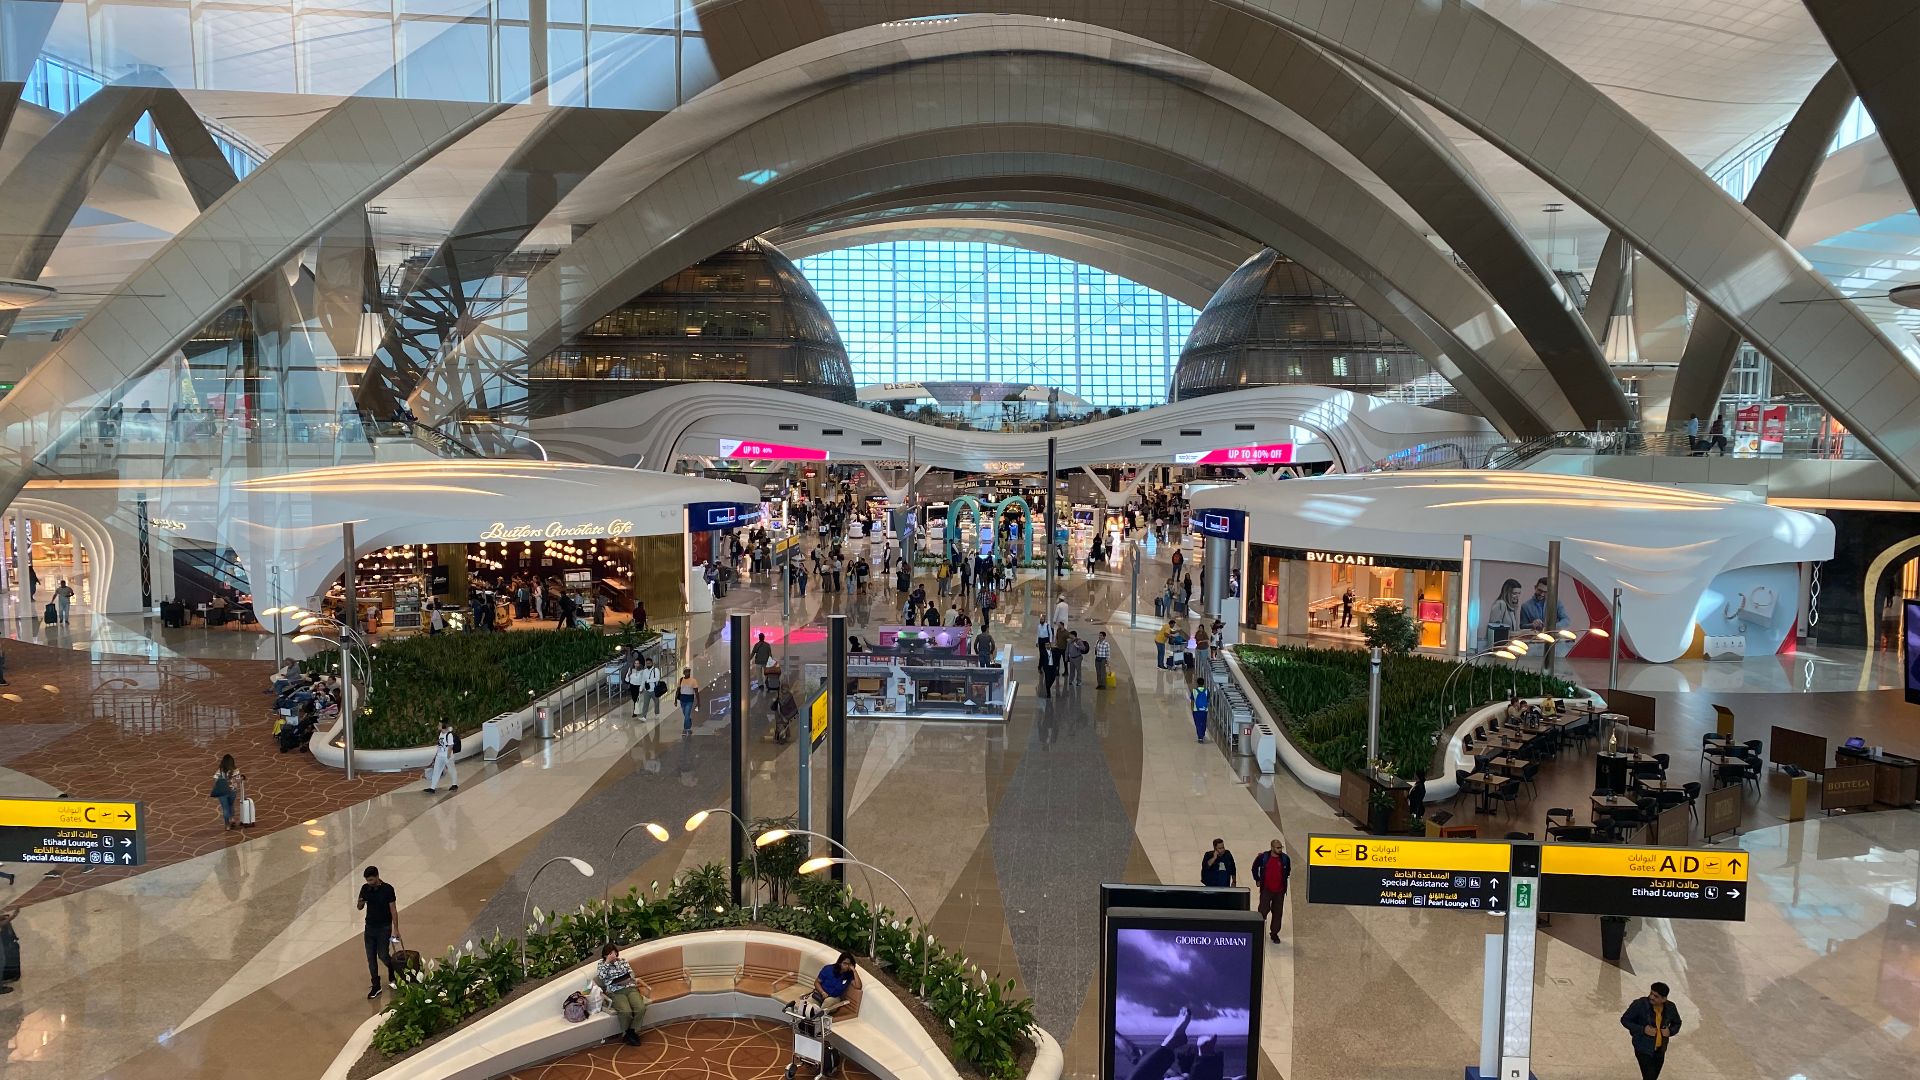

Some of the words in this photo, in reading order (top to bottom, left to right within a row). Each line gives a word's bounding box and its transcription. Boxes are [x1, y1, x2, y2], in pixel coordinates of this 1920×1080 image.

[743, 446, 752, 454] UP
[752, 446, 760, 455] TO
[1228, 449, 1239, 459] UP
[1241, 449, 1251, 459] TO
[1253, 449, 1268, 458] 40%
[1270, 449, 1282, 458] OFF
[481, 522, 543, 540] Butlers
[545, 522, 604, 538] Chocolate
[607, 519, 634, 537] Café
[1306, 551, 1374, 566] BVLGARI
[1828, 779, 1872, 792] BOTTEGA
[60, 815, 82, 823] Gates
[84, 807, 96, 823] C
[79, 831, 98, 839] صالات
[43, 838, 67, 847] Etihad
[68, 839, 99, 849] Lounges
[1355, 844, 1369, 861] B
[22, 853, 48, 863] Special
[49, 854, 86, 863] Assistance
[1371, 854, 1397, 863] Gates
[1628, 854, 1657, 864] البوابات
[1629, 863, 1656, 872] Gates
[1659, 855, 1677, 873] A
[1683, 856, 1700, 873] D
[1394, 870, 1416, 879] الخاصة
[1417, 871, 1450, 880] المساعدة
[1381, 878, 1409, 887] Special
[1410, 879, 1449, 888] Assistance
[1649, 879, 1675, 889] الاتحاد
[1676, 880, 1700, 889] صالات
[1380, 890, 1396, 898] AUH
[1632, 888, 1660, 897] Etihad
[1662, 889, 1699, 899] Lounges
[1380, 897, 1407, 905] AUHotel
[1445, 900, 1469, 909] Lounge
[1175, 935, 1211, 945] GIORGIO
[1213, 937, 1247, 947] ARMANI
